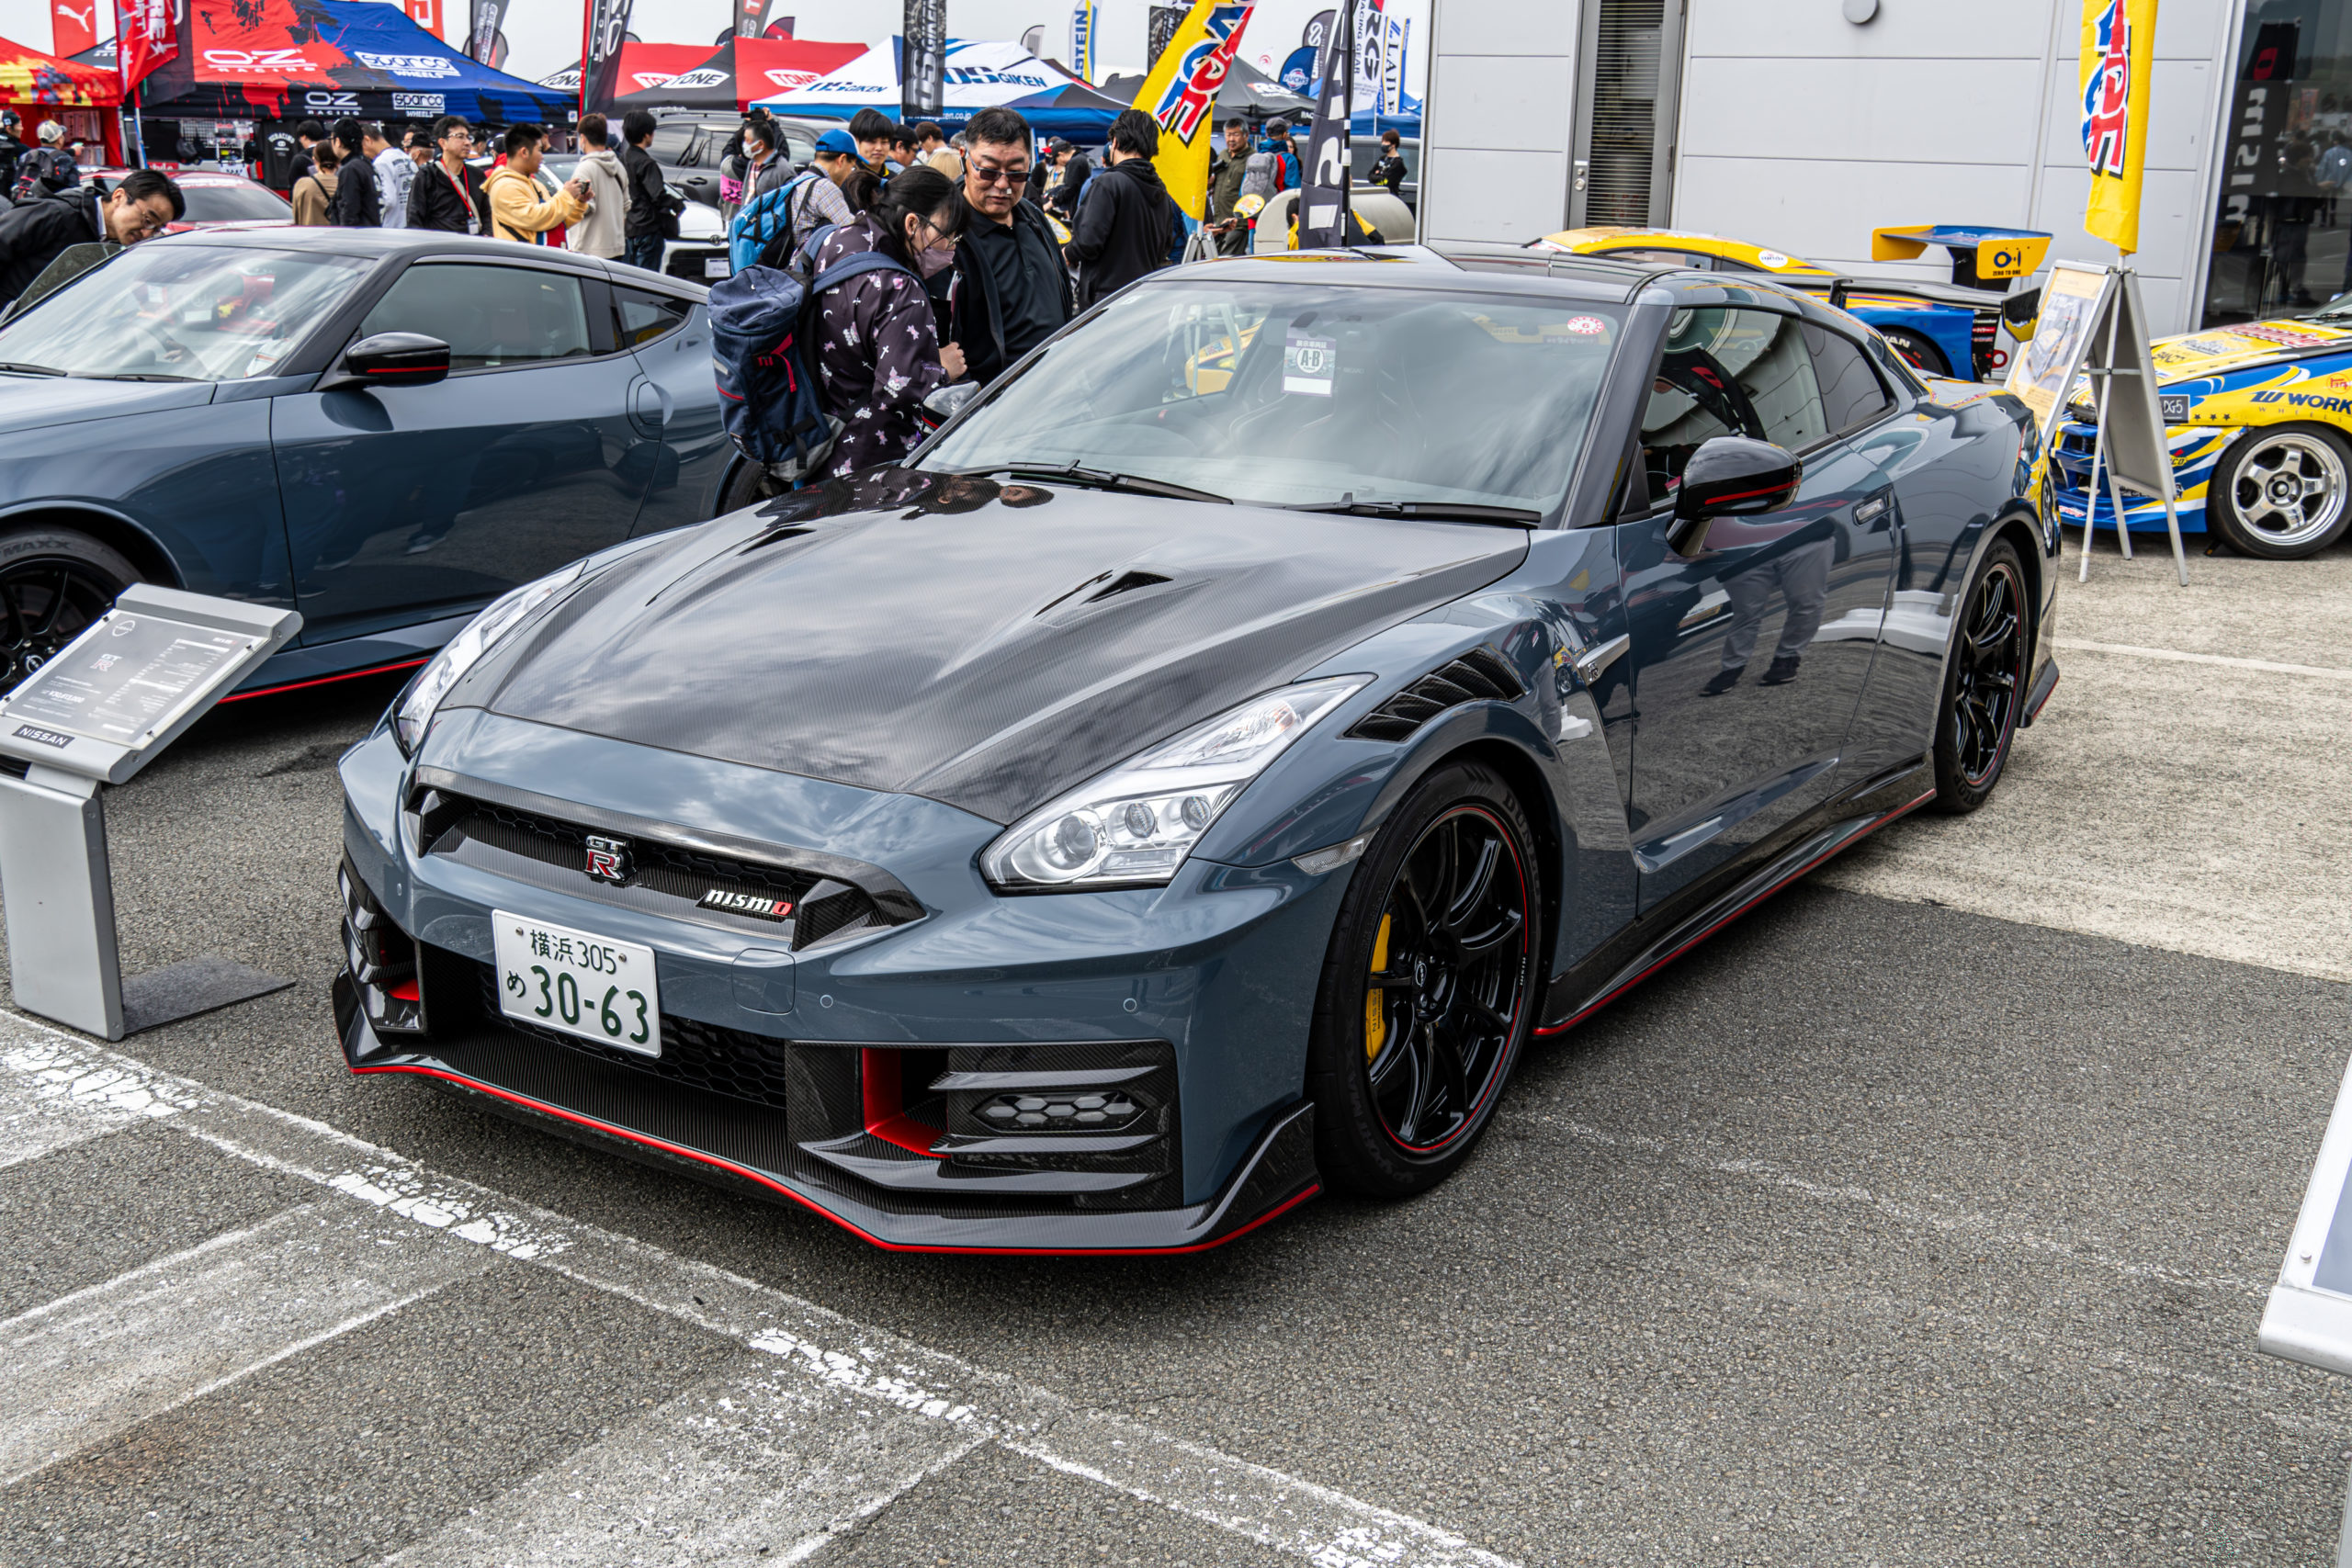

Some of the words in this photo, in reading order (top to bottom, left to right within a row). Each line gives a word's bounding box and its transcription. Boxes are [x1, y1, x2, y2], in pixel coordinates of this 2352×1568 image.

[1074, 9, 1089, 78] LSTEIN
[673, 73, 724, 85] TONE
[998, 73, 1048, 88] GIKEN
[394, 95, 444, 109] sparco
[2288, 392, 2352, 415] WORK
[18, 726, 69, 747] NISSAN
[585, 835, 628, 851] GT
[584, 849, 624, 881] R
[704, 888, 794, 917] nismo
[529, 929, 575, 965] 横浜
[577, 941, 617, 976] 305
[506, 969, 526, 998] め
[530, 964, 650, 1044] 30-63
